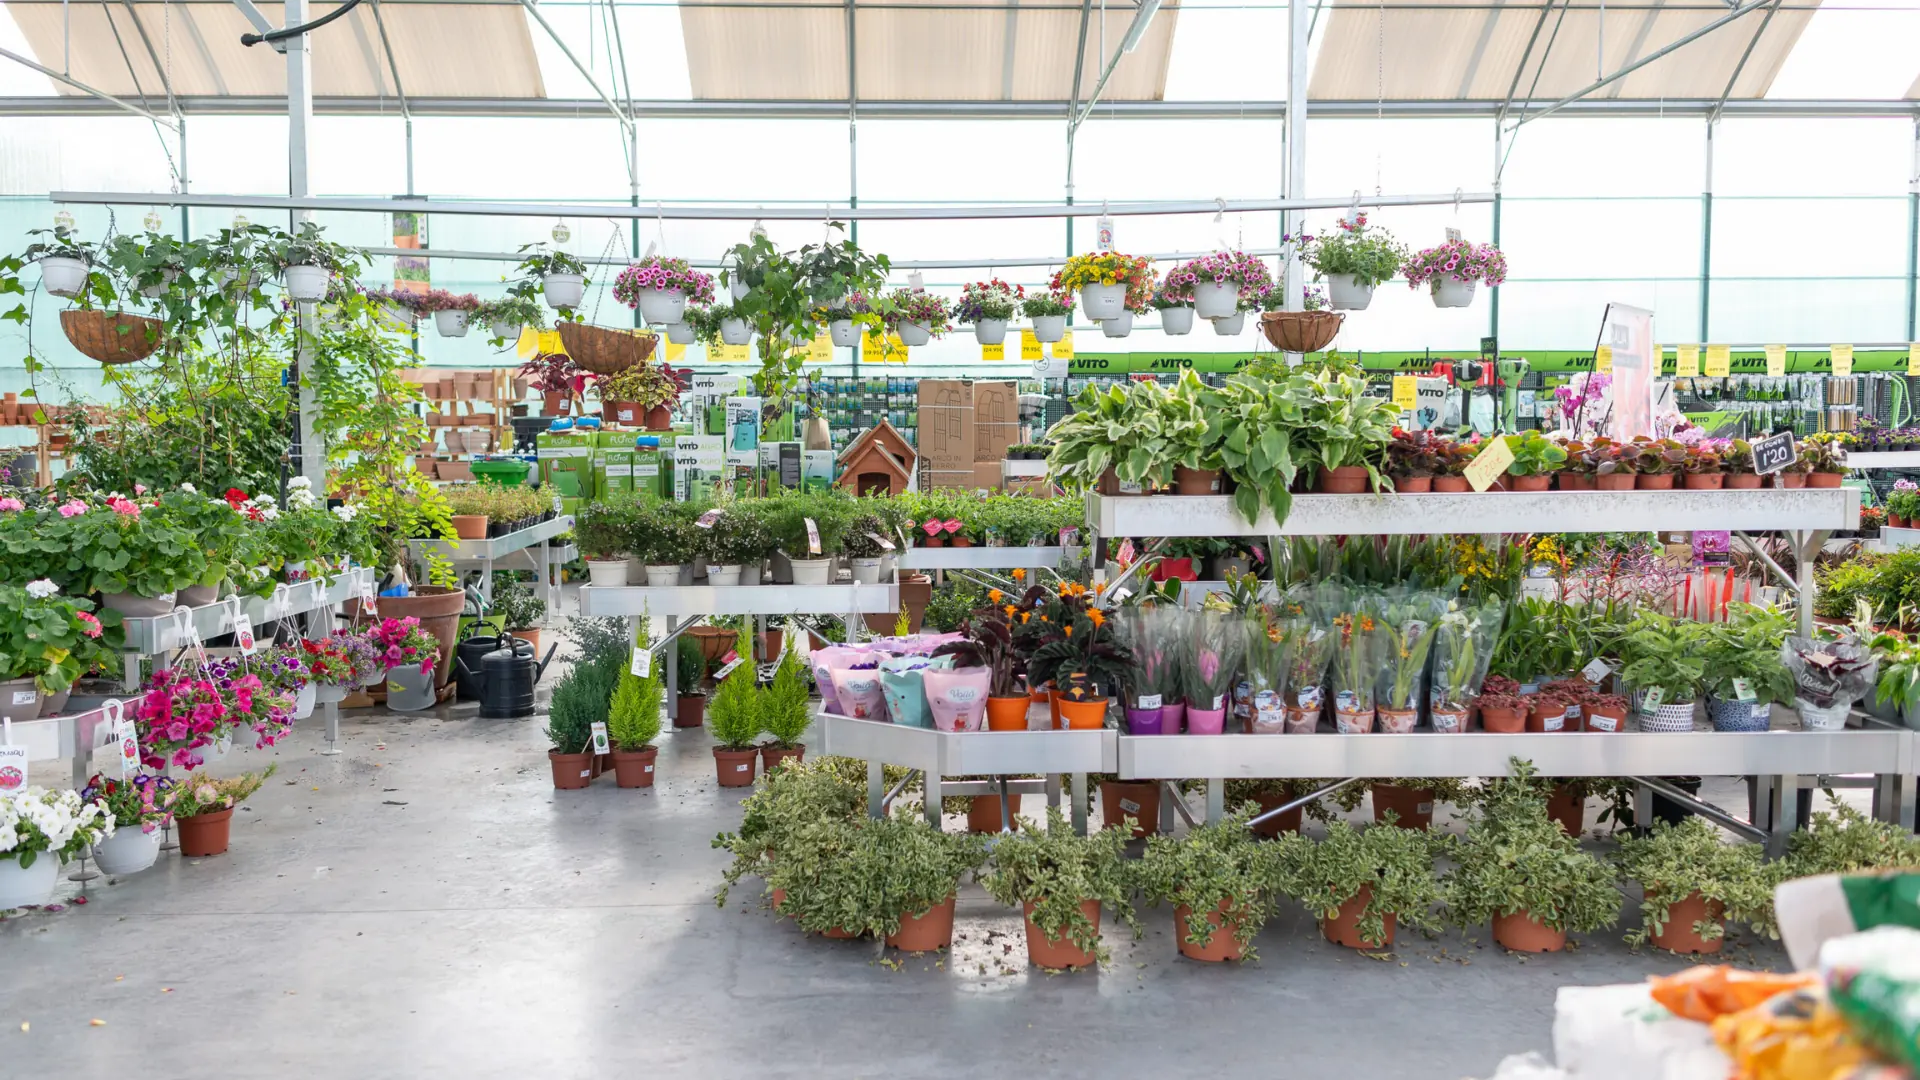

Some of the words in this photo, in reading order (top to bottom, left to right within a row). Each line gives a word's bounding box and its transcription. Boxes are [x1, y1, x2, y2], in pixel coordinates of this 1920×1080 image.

[1076, 359, 1109, 369] VITO
[1160, 358, 1193, 369] VITO
[1418, 388, 1443, 397] VITO
